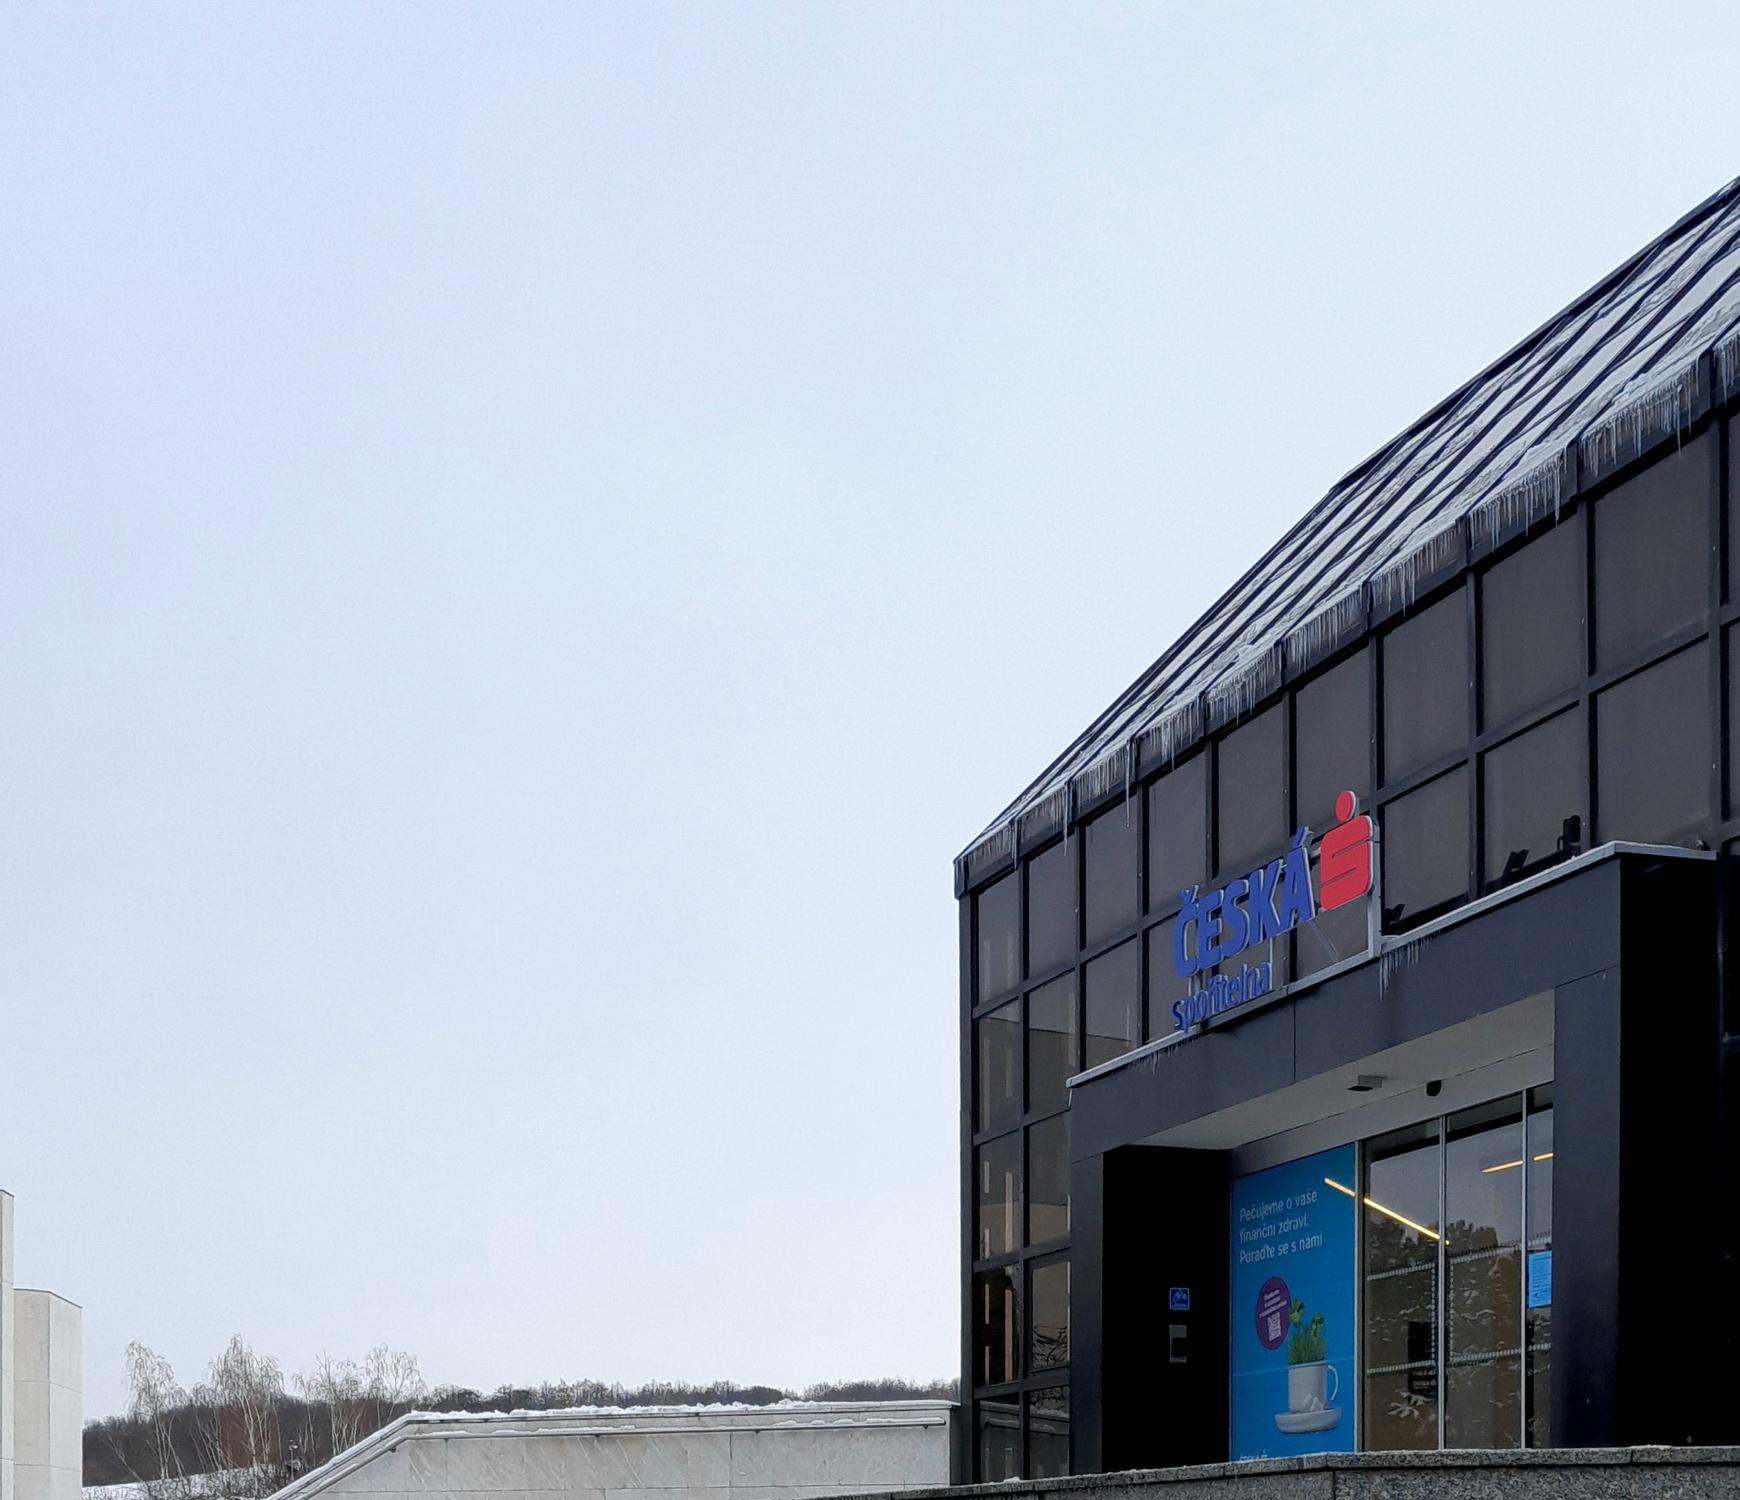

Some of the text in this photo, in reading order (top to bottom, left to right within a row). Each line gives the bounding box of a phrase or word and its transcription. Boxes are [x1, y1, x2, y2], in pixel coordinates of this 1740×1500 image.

[1174, 826, 1316, 977] ČESKÁ
[1240, 1188, 1317, 1222] Pečujeme o vaše
[1240, 1222, 1276, 1244] finanční
[1278, 1243, 1289, 1257] se
[1291, 1240, 1297, 1253] s
